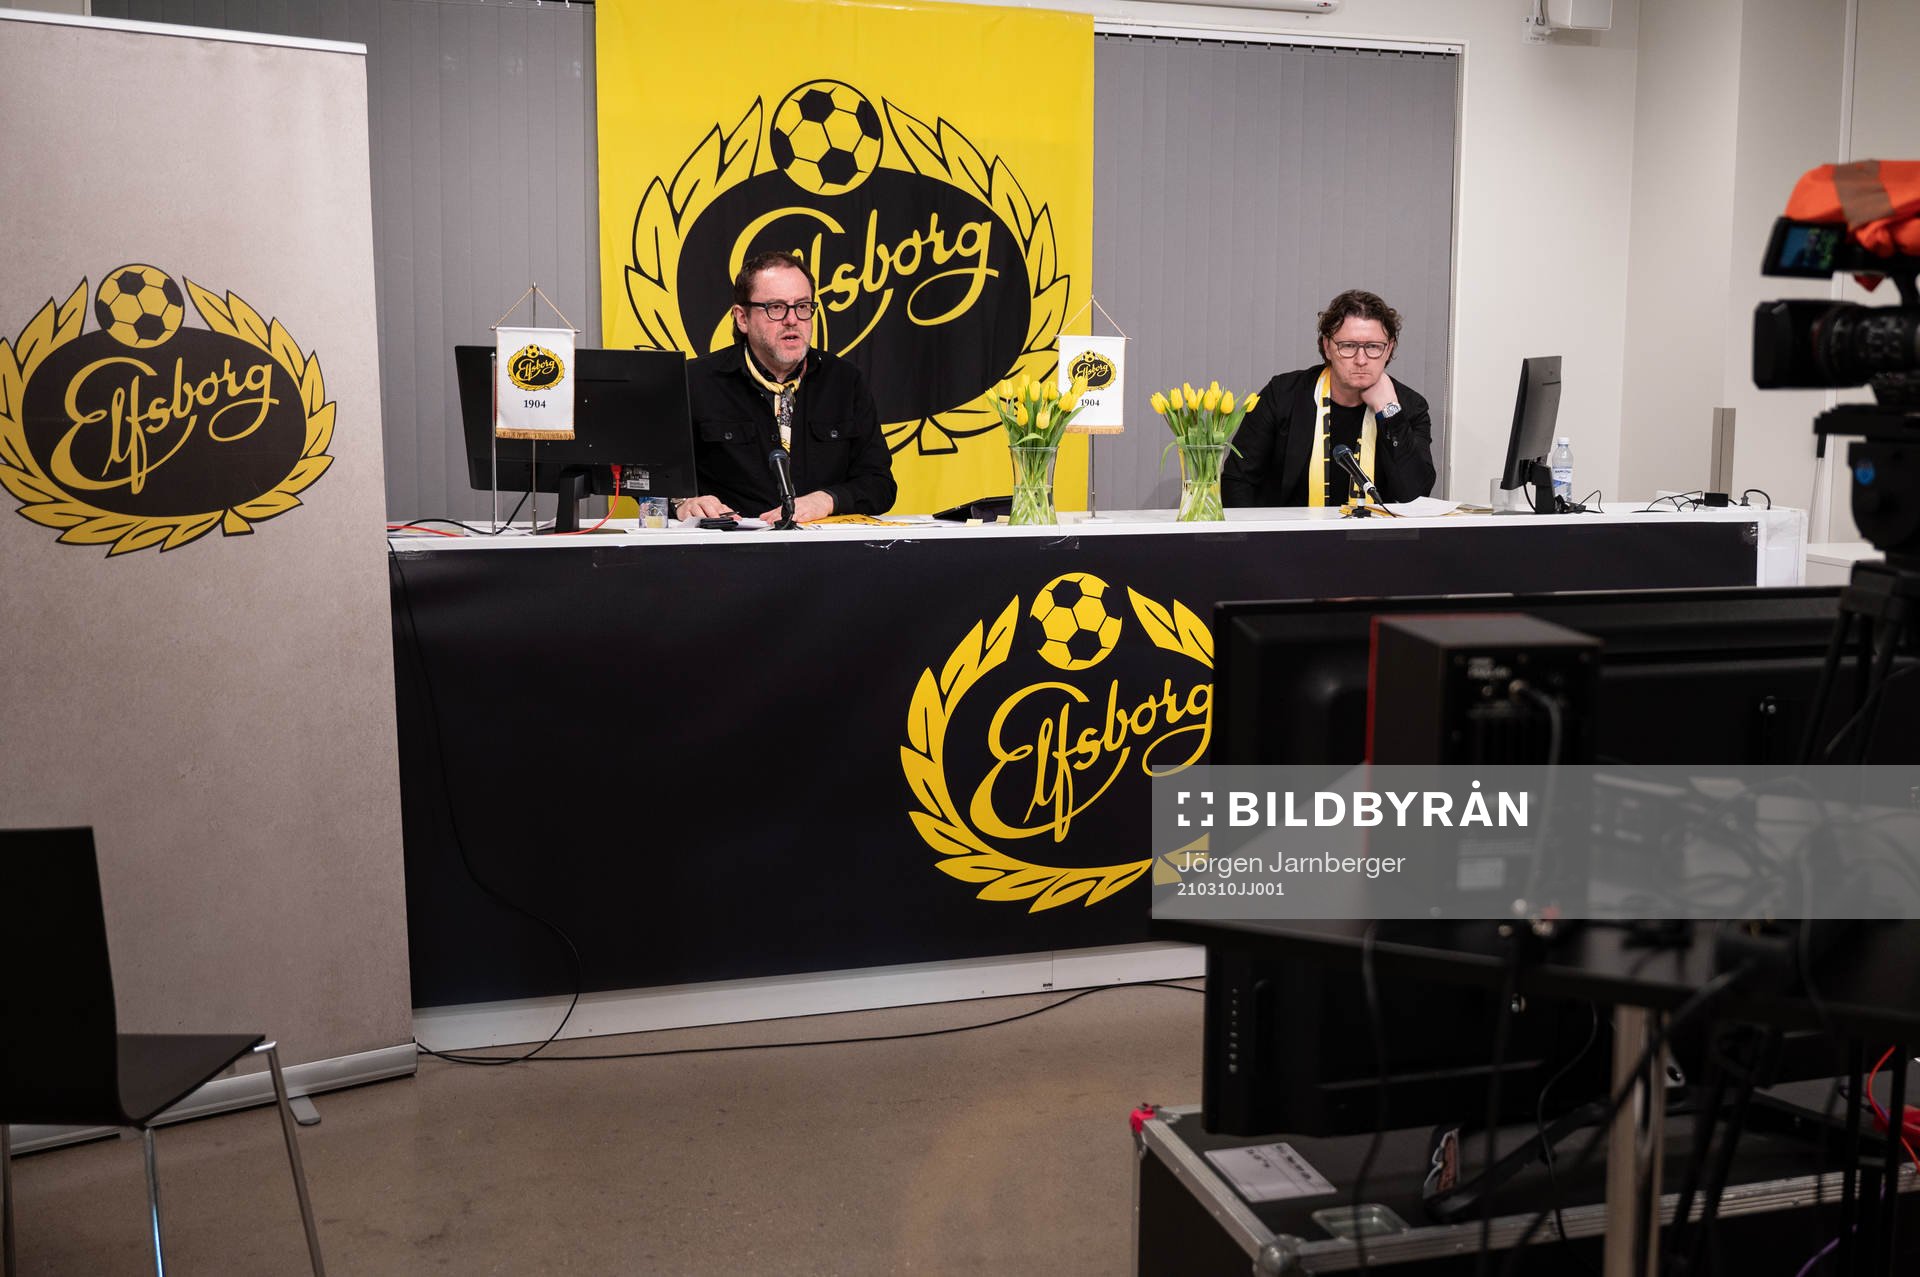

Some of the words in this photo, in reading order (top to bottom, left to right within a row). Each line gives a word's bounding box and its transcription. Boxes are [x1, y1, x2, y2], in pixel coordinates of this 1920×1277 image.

[515, 358, 556, 382] Elfsborg
[523, 399, 546, 409] 1904
[1080, 398, 1100, 407] 1904
[50, 356, 280, 495] Elfsborg
[969, 678, 1214, 843] Elfsborg
